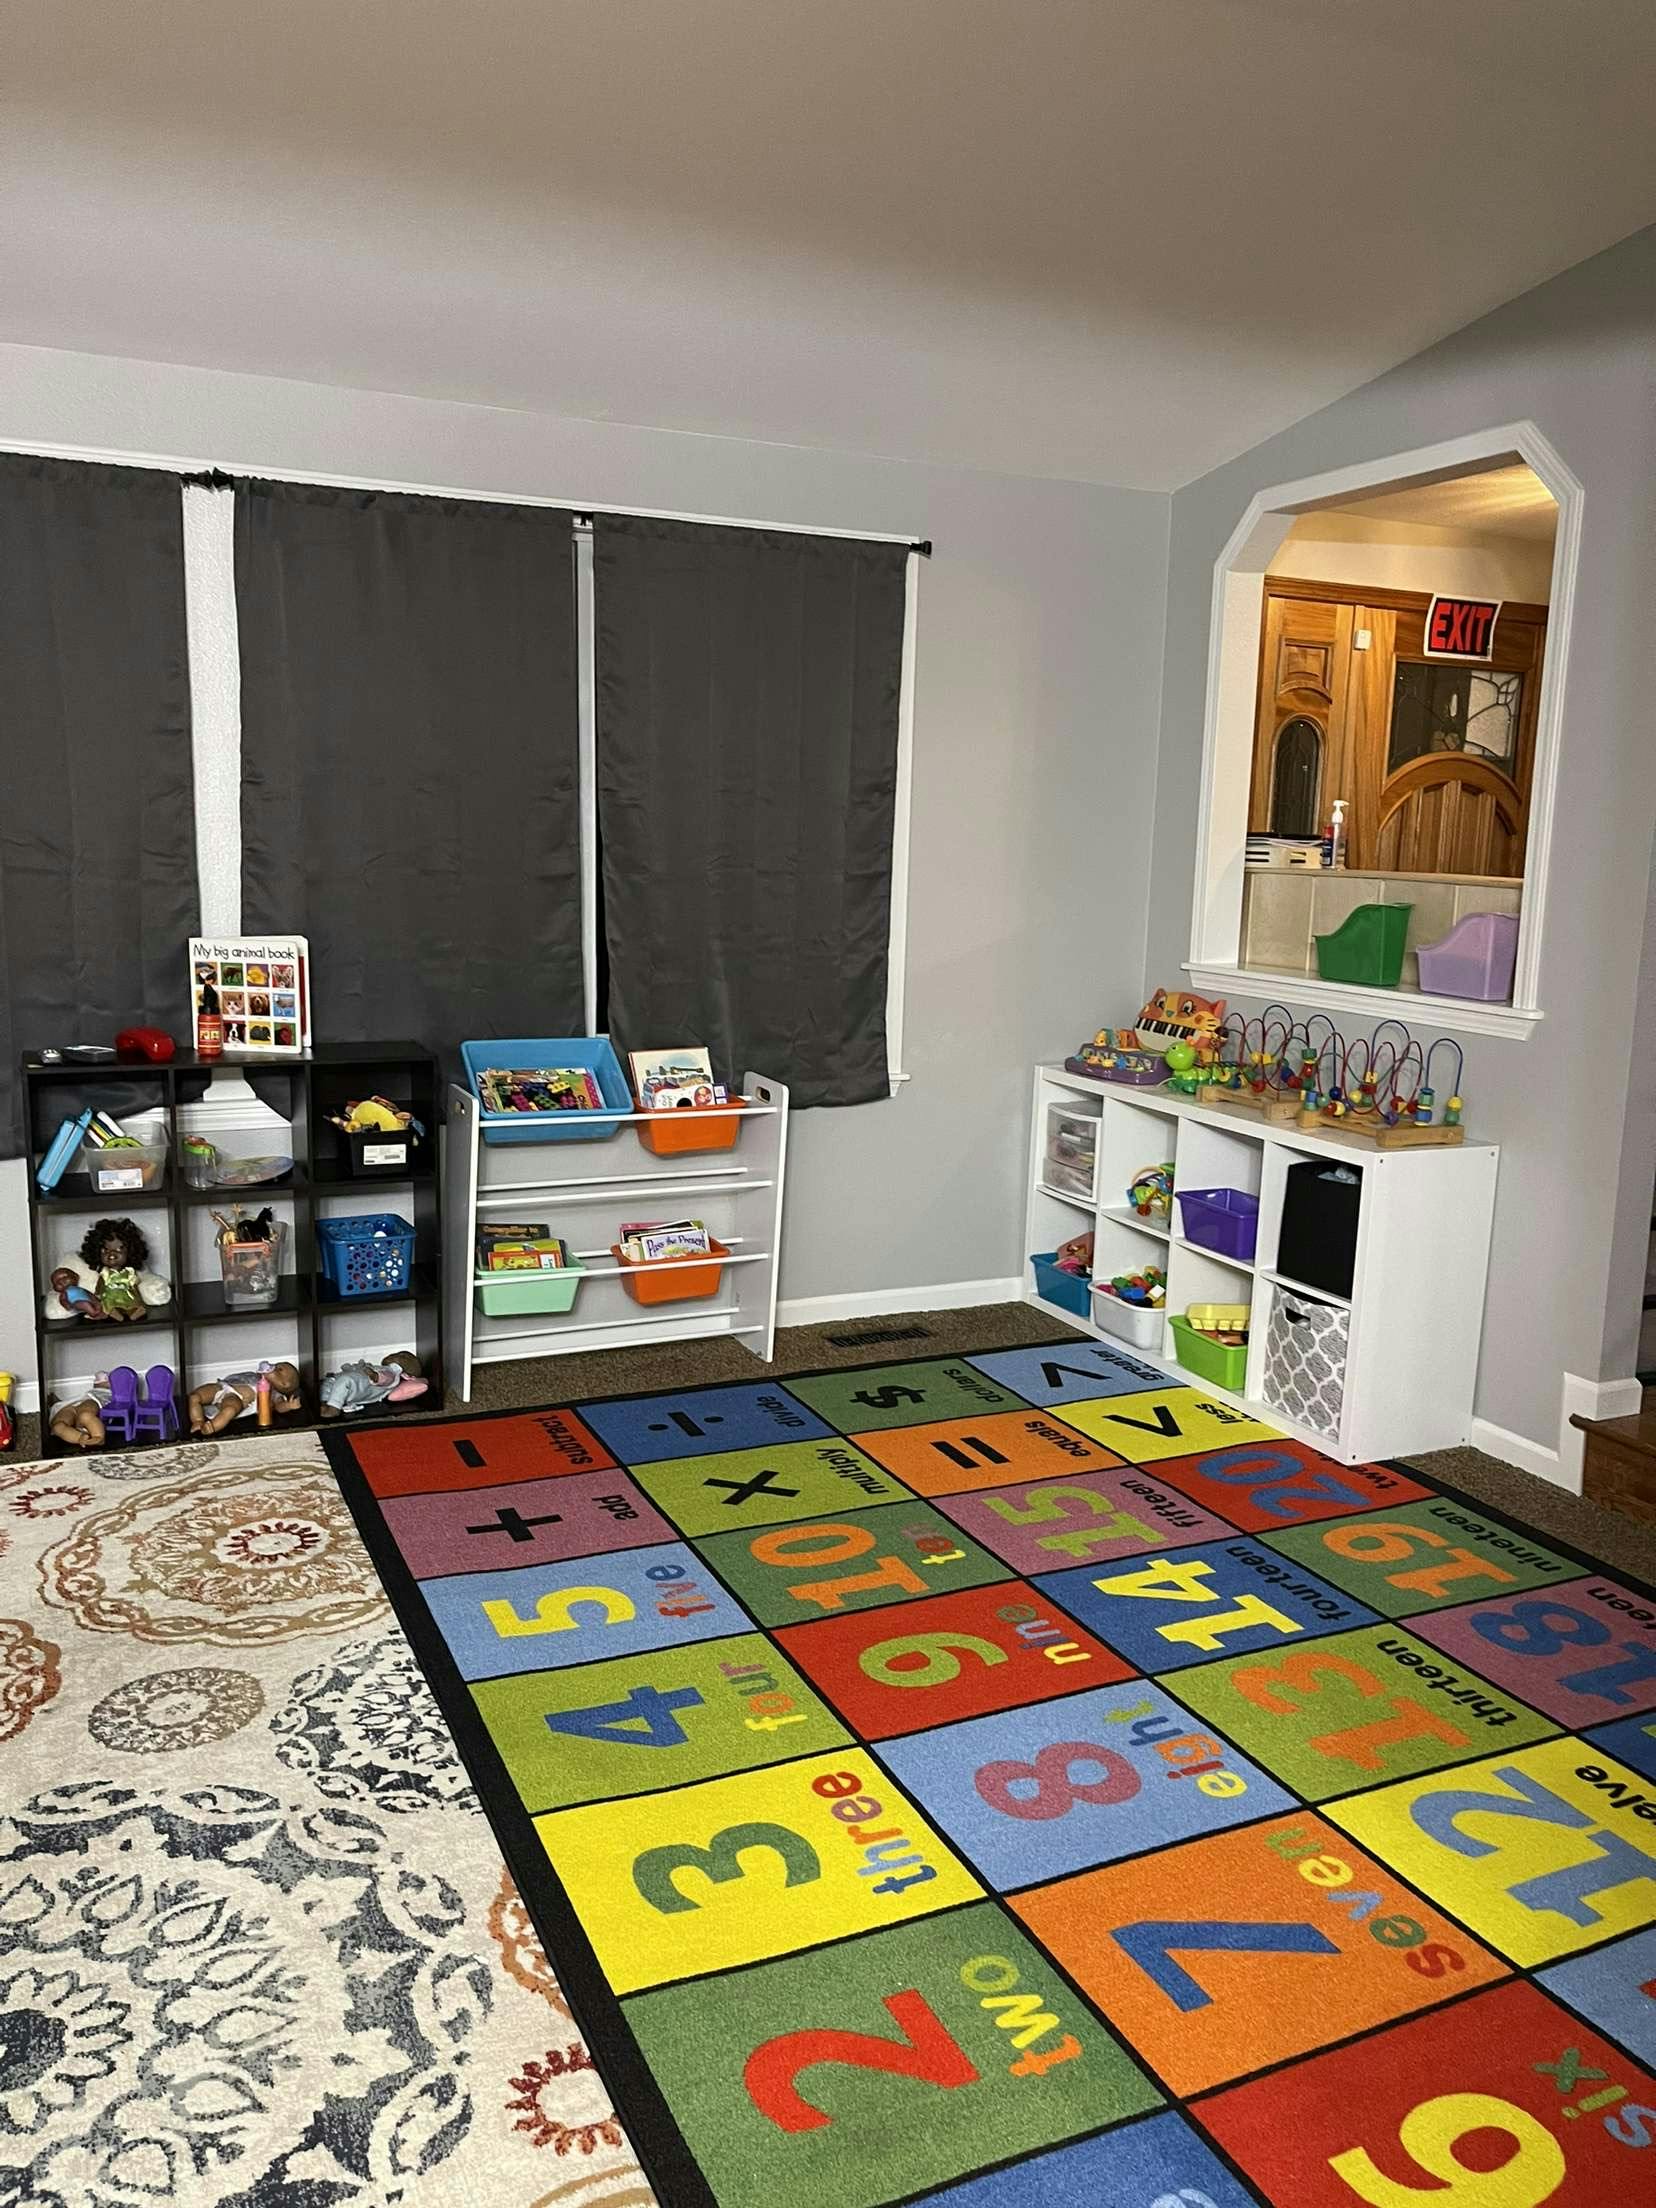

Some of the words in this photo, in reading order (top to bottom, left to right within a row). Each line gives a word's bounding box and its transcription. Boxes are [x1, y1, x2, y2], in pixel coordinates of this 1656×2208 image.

[1431, 602, 1494, 652] EXIT
[193, 943, 212, 959] My
[213, 945, 229, 960] big
[231, 946, 265, 959] animal
[267, 946, 296, 960] book
[646, 1239, 665, 1257] Pass
[666, 1236, 677, 1244] the
[678, 1234, 707, 1250] Present
[850, 1385, 926, 1408] $
[942, 1368, 1005, 1403] dollars
[1089, 1349, 1165, 1380] greater
[531, 1415, 594, 1465] subtract
[756, 1394, 806, 1429] divide
[1025, 1420, 1091, 1458] equals
[1195, 1403, 1244, 1424] less
[815, 1448, 890, 1495] multiply
[1119, 1479, 1205, 1529] fifteen
[1196, 1449, 1373, 1518] 20
[591, 1494, 640, 1521] add
[981, 1485, 1169, 1558] 15
[1428, 1505, 1564, 1573] nineteen
[645, 1565, 716, 1617] five
[750, 1523, 930, 1610] 10
[1225, 1545, 1353, 1622] fourteen
[1322, 1522, 1520, 1597] 19
[481, 1585, 637, 1638] 5
[996, 1604, 1092, 1665] nine
[1091, 1558, 1304, 1652] 14
[1586, 1587, 1656, 1629] een
[858, 1631, 1009, 1688] 9
[1376, 1638, 1519, 1728] thirteen
[1471, 1600, 1656, 1706] 18
[544, 1685, 705, 1748] 4
[719, 1660, 808, 1733] four
[1231, 1651, 1472, 1771] 13
[974, 1741, 1142, 1822] 8
[1104, 1700, 1248, 1798] eight
[1575, 1765, 1656, 1826] elve
[811, 1770, 938, 1896] three
[1409, 1766, 1656, 1928] 12
[632, 1821, 822, 1916] 3
[1264, 1827, 1466, 1979] seven
[1109, 1920, 1342, 2013] 7
[959, 1954, 1083, 2078] two
[743, 1988, 980, 2134] 2
[1532, 2048, 1656, 2148] six
[1328, 2091, 1566, 2208] 6
